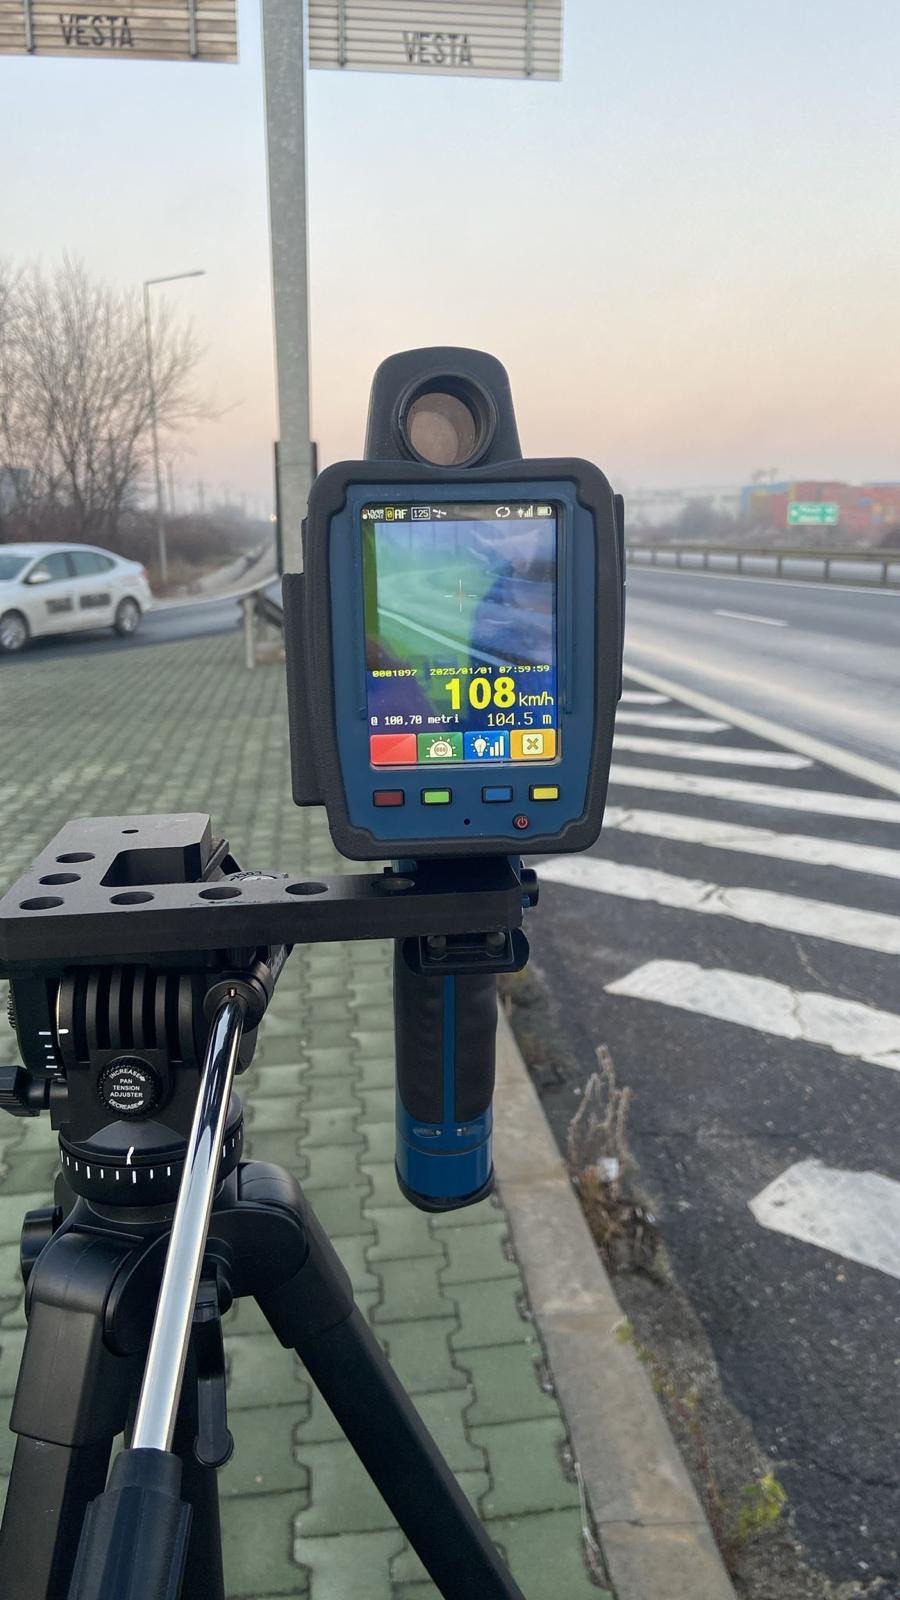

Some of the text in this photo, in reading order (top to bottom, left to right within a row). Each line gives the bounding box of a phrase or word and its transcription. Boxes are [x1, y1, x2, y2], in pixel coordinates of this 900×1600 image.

[59, 13, 134, 48] VESTA
[402, 30, 474, 66] VESTA
[395, 509, 408, 519] AF
[413, 509, 429, 518] 125
[372, 665, 550, 677] 0001897 2025/01/01 07:59:59
[445, 676, 554, 710] 108 km/h
[427, 713, 460, 724] metri
[487, 711, 552, 727] 104.5 m
[109, 1068, 141, 1079] INCREASE
[108, 1098, 139, 1110] DECREASE
